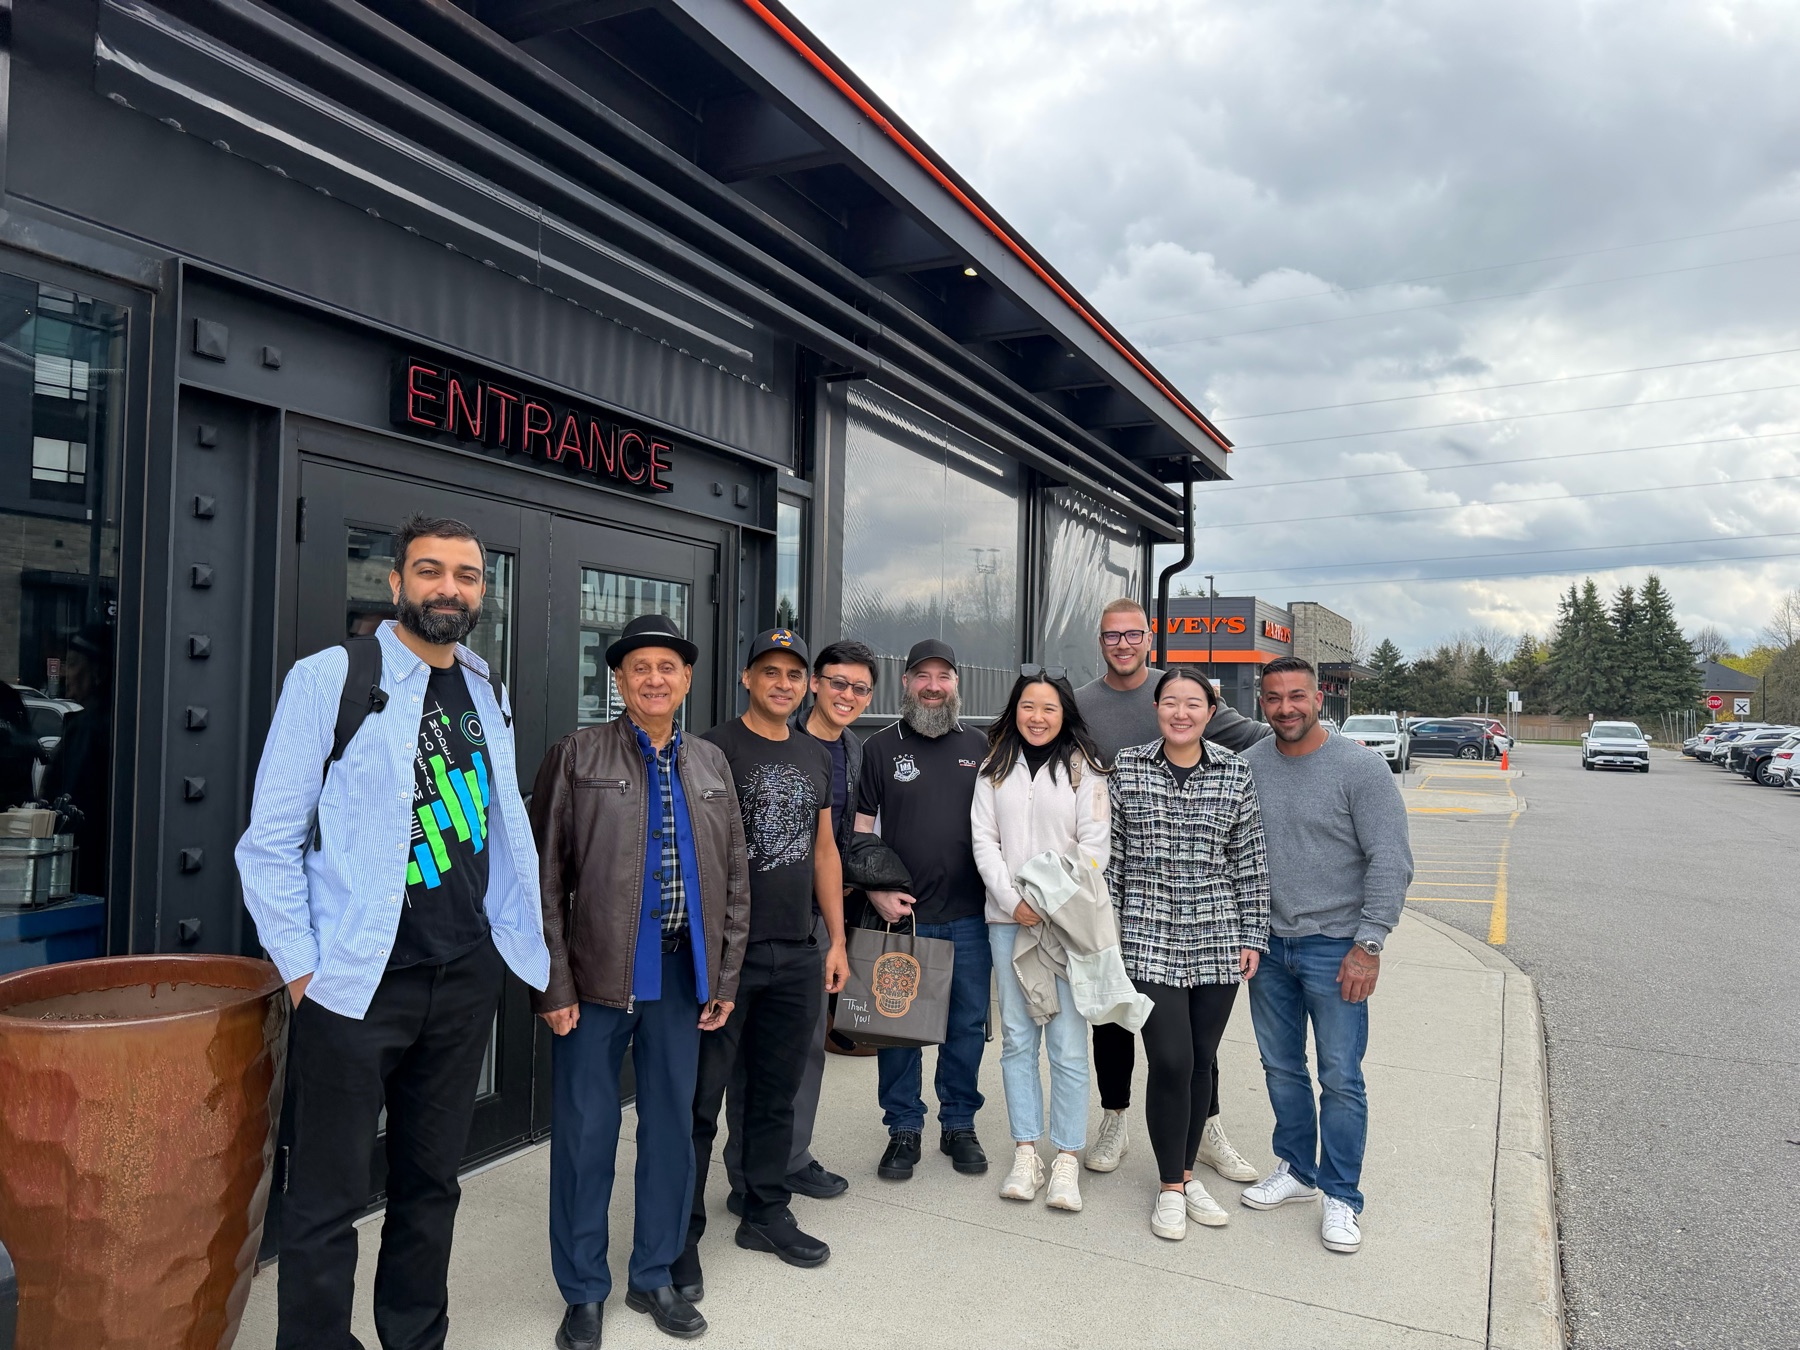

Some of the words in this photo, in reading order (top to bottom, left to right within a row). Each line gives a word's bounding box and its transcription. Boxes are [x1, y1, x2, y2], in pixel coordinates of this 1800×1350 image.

[408, 357, 674, 492] ENTRANCE
[1151, 616, 1246, 634] VEY'S
[420, 732, 435, 751] TO
[428, 718, 455, 765] MODEL
[415, 747, 436, 795] METAL
[842, 998, 870, 1013] Thank
